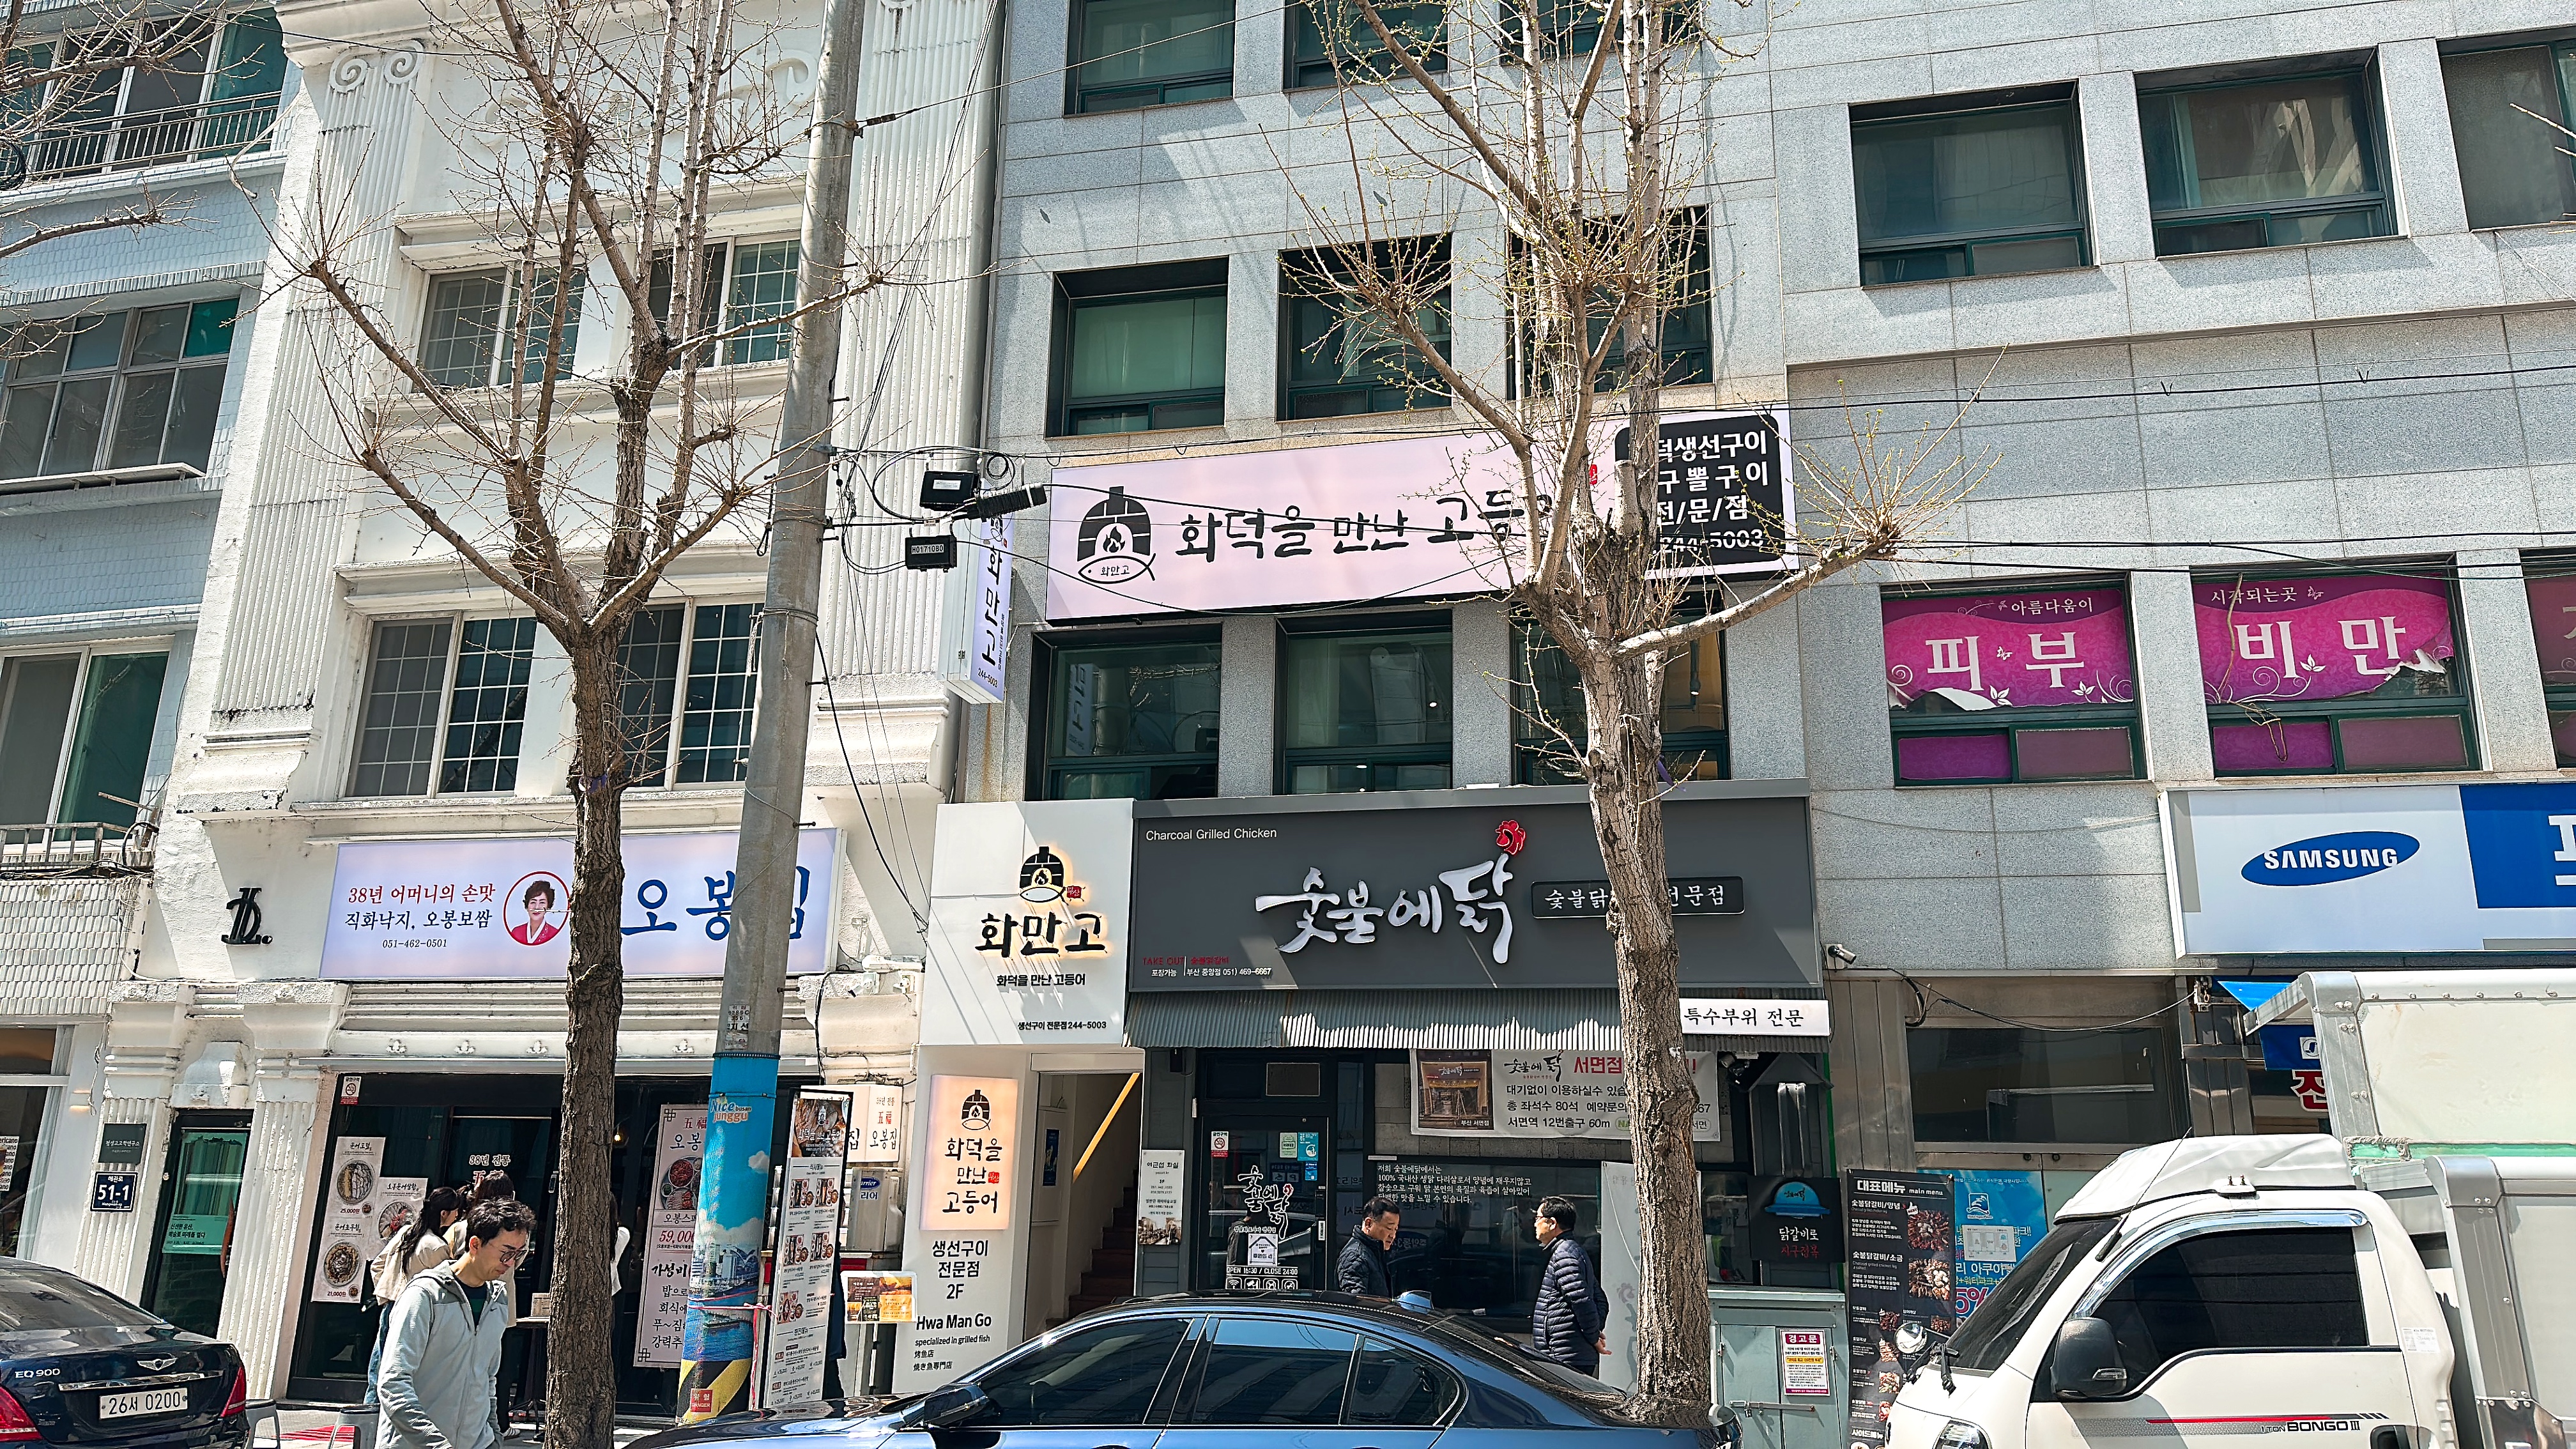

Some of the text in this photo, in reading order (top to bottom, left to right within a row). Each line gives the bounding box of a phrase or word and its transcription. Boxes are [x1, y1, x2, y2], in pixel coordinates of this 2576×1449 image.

[1659, 429, 1767, 463] 덕생선구이
[1175, 488, 1552, 563] 화덕을 만난 고등
[1100, 565, 1131, 578] 화만고
[2211, 586, 2298, 604] 시작되는곳
[2011, 597, 2093, 617] 아름다움이
[1146, 827, 1277, 841] Charcoal Grilled Chicken
[2264, 848, 2398, 870] SAMSUNG
[348, 882, 496, 905] 38년 어머니의 손맛
[345, 908, 493, 931] 직화낙지, 오봉보쌈
[974, 910, 1108, 959] 화만고
[382, 938, 448, 949] 051-462-0501
[1142, 956, 1184, 966] TAKE OUT
[1151, 969, 1177, 977] 포장가능
[1186, 967, 1272, 976] 부산 중앙점 051) 469-6667
[996, 972, 1086, 987] 화덕을 만난 고등어
[1683, 1007, 1804, 1028] 특수부위 전문
[1017, 1020, 1107, 1032] 생선구이 전문점 244-5003
[1573, 1056, 1623, 1074] 서면점
[1506, 1084, 1547, 1096] 대기없이
[1551, 1085, 1602, 1096] 이용하실수
[710, 1100, 735, 1113] Nice
[1506, 1100, 1628, 1112] 총 좌석수 80석 예약문의
[713, 1112, 749, 1124] junggu
[1508, 1117, 1538, 1128] 서면역
[1543, 1117, 1585, 1128] 12번출구
[1588, 1118, 1610, 1128] 60m
[870, 1128, 897, 1150] 오봉집
[944, 1136, 1003, 1163] 화덕을
[469, 1154, 511, 1167] 38년 전통
[956, 1166, 987, 1186] 만난
[1377, 1165, 1391, 1173] 저희
[1397, 1174, 1418, 1183] 국내산
[1420, 1175, 1435, 1183] 생닭
[1437, 1176, 1471, 1184] 다리살로서
[1473, 1176, 1494, 1184] 양념에
[1495, 1176, 1532, 1186] 재우지않고
[1857, 1179, 1906, 1193] 대표메뉴
[98, 1184, 130, 1201] 51-1
[1432, 1184, 1453, 1194] 본연의
[942, 1189, 999, 1215] 고등어
[1400, 1193, 1415, 1203] 맛을
[1417, 1194, 1431, 1203] 느낄
[1433, 1195, 1441, 1203] 수
[1442, 1195, 1473, 1204] 있습니다.
[1779, 1226, 1820, 1241] 닭갈비로
[931, 1239, 989, 1259] 생선구이
[1852, 1251, 1903, 1262] 숯불닭갈비/소금
[651, 1262, 687, 1278] 가성비
[937, 1260, 980, 1280] 전문점
[946, 1283, 965, 1301] 2F
[652, 1319, 686, 1332] 푸~짐
[916, 1312, 992, 1331] Hwa Man Go
[651, 1335, 684, 1349] 강력추
[915, 1333, 991, 1347] specialized in grilled fish
[1788, 1334, 1818, 1344] 경고문
[109, 1391, 181, 1416] 26서 0200
[2287, 1421, 2349, 1432] BONGO
